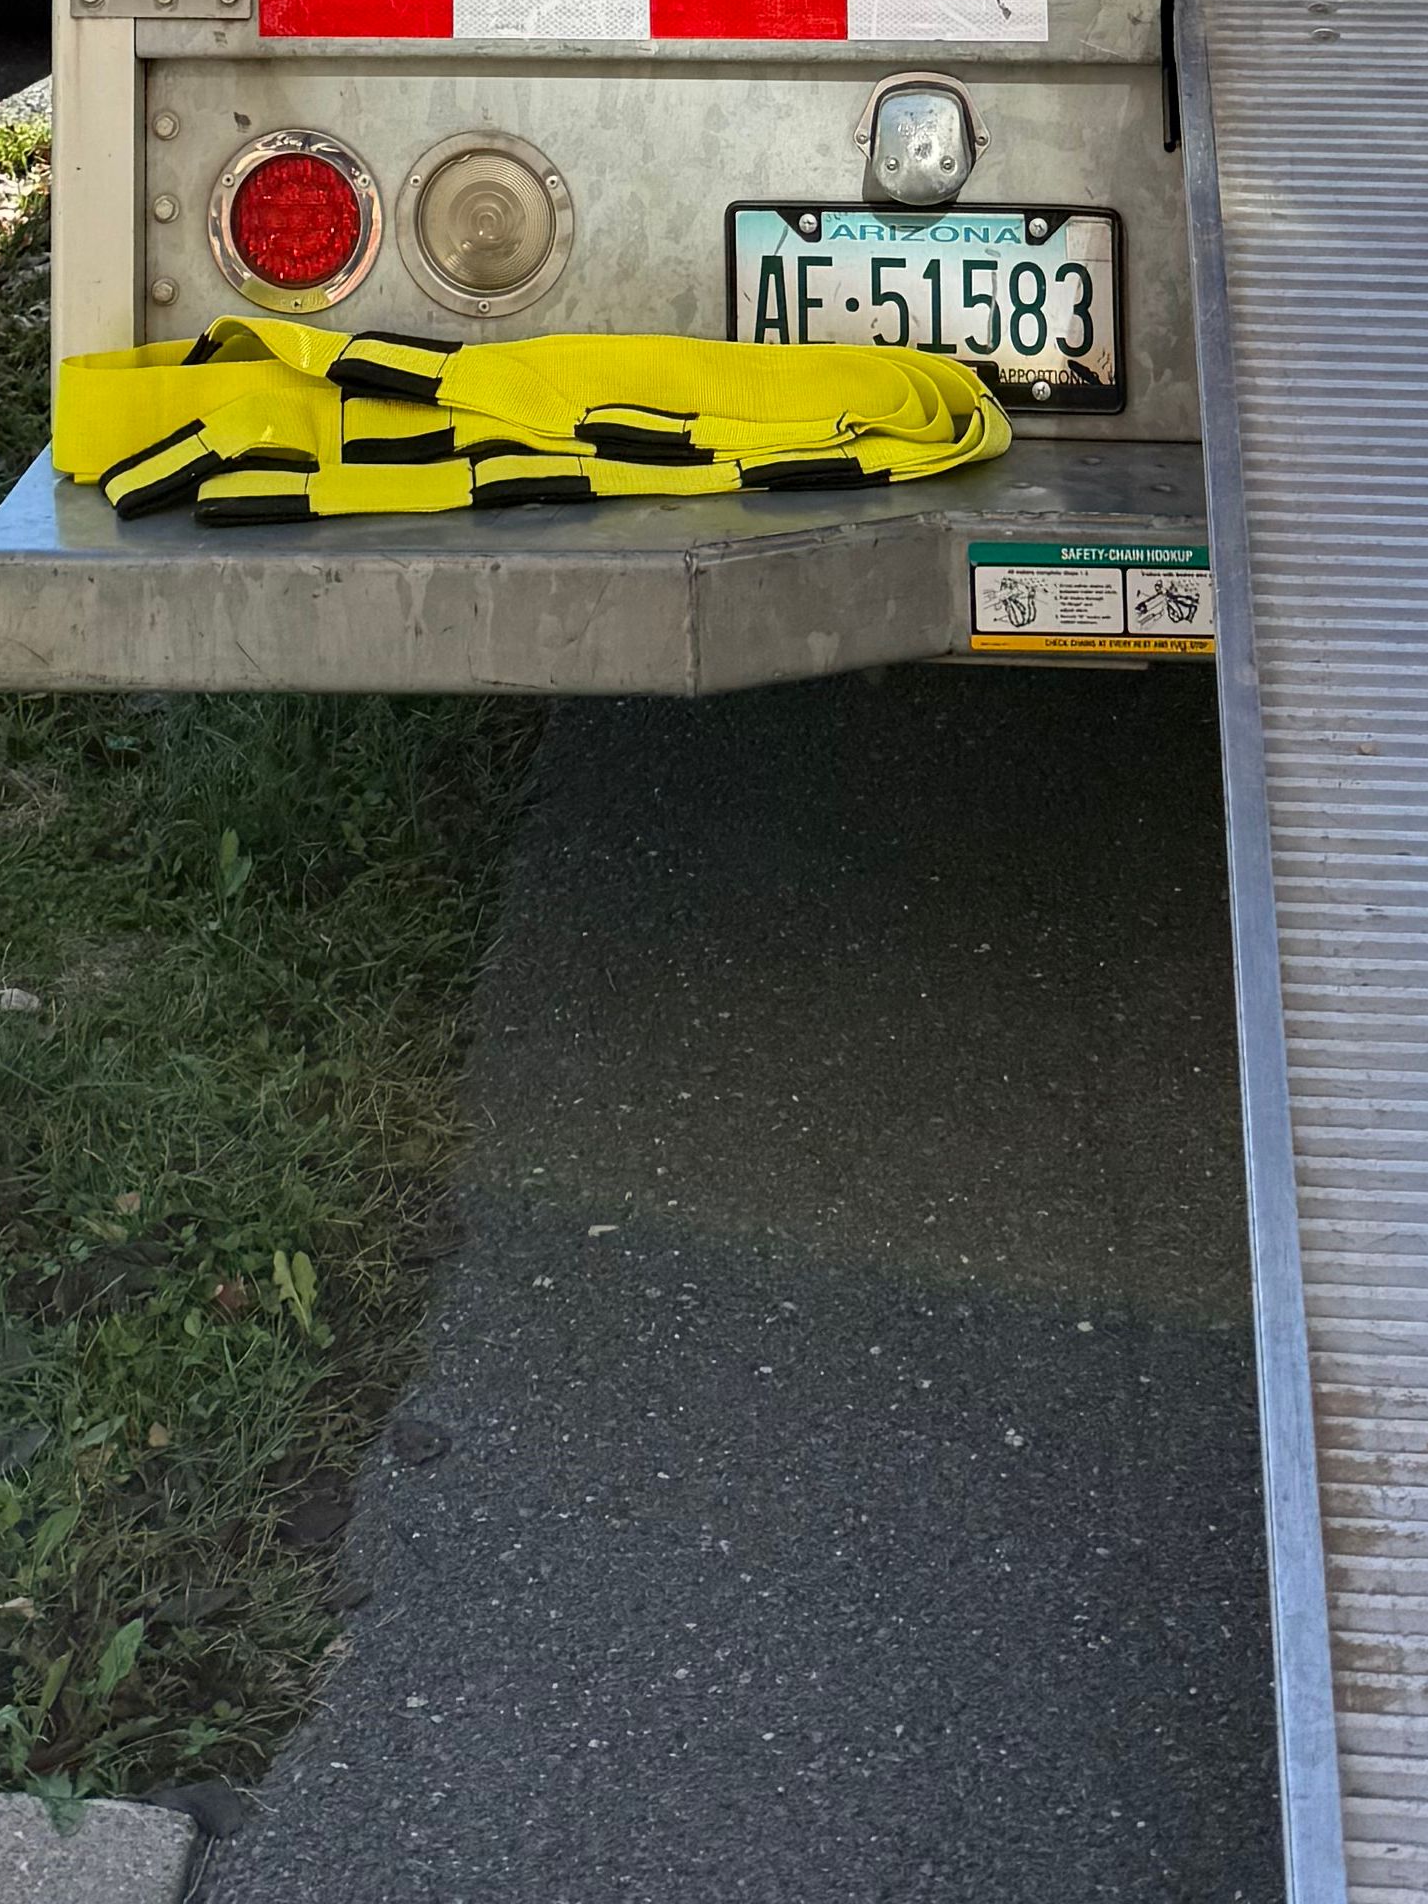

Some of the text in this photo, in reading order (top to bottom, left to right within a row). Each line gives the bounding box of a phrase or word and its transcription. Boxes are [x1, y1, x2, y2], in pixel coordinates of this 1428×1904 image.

[828, 223, 1022, 245] ARIZONA
[1061, 548, 1193, 562] SAFETY-CHAIN HOOKUP
[1045, 638, 1068, 647] CHECK
